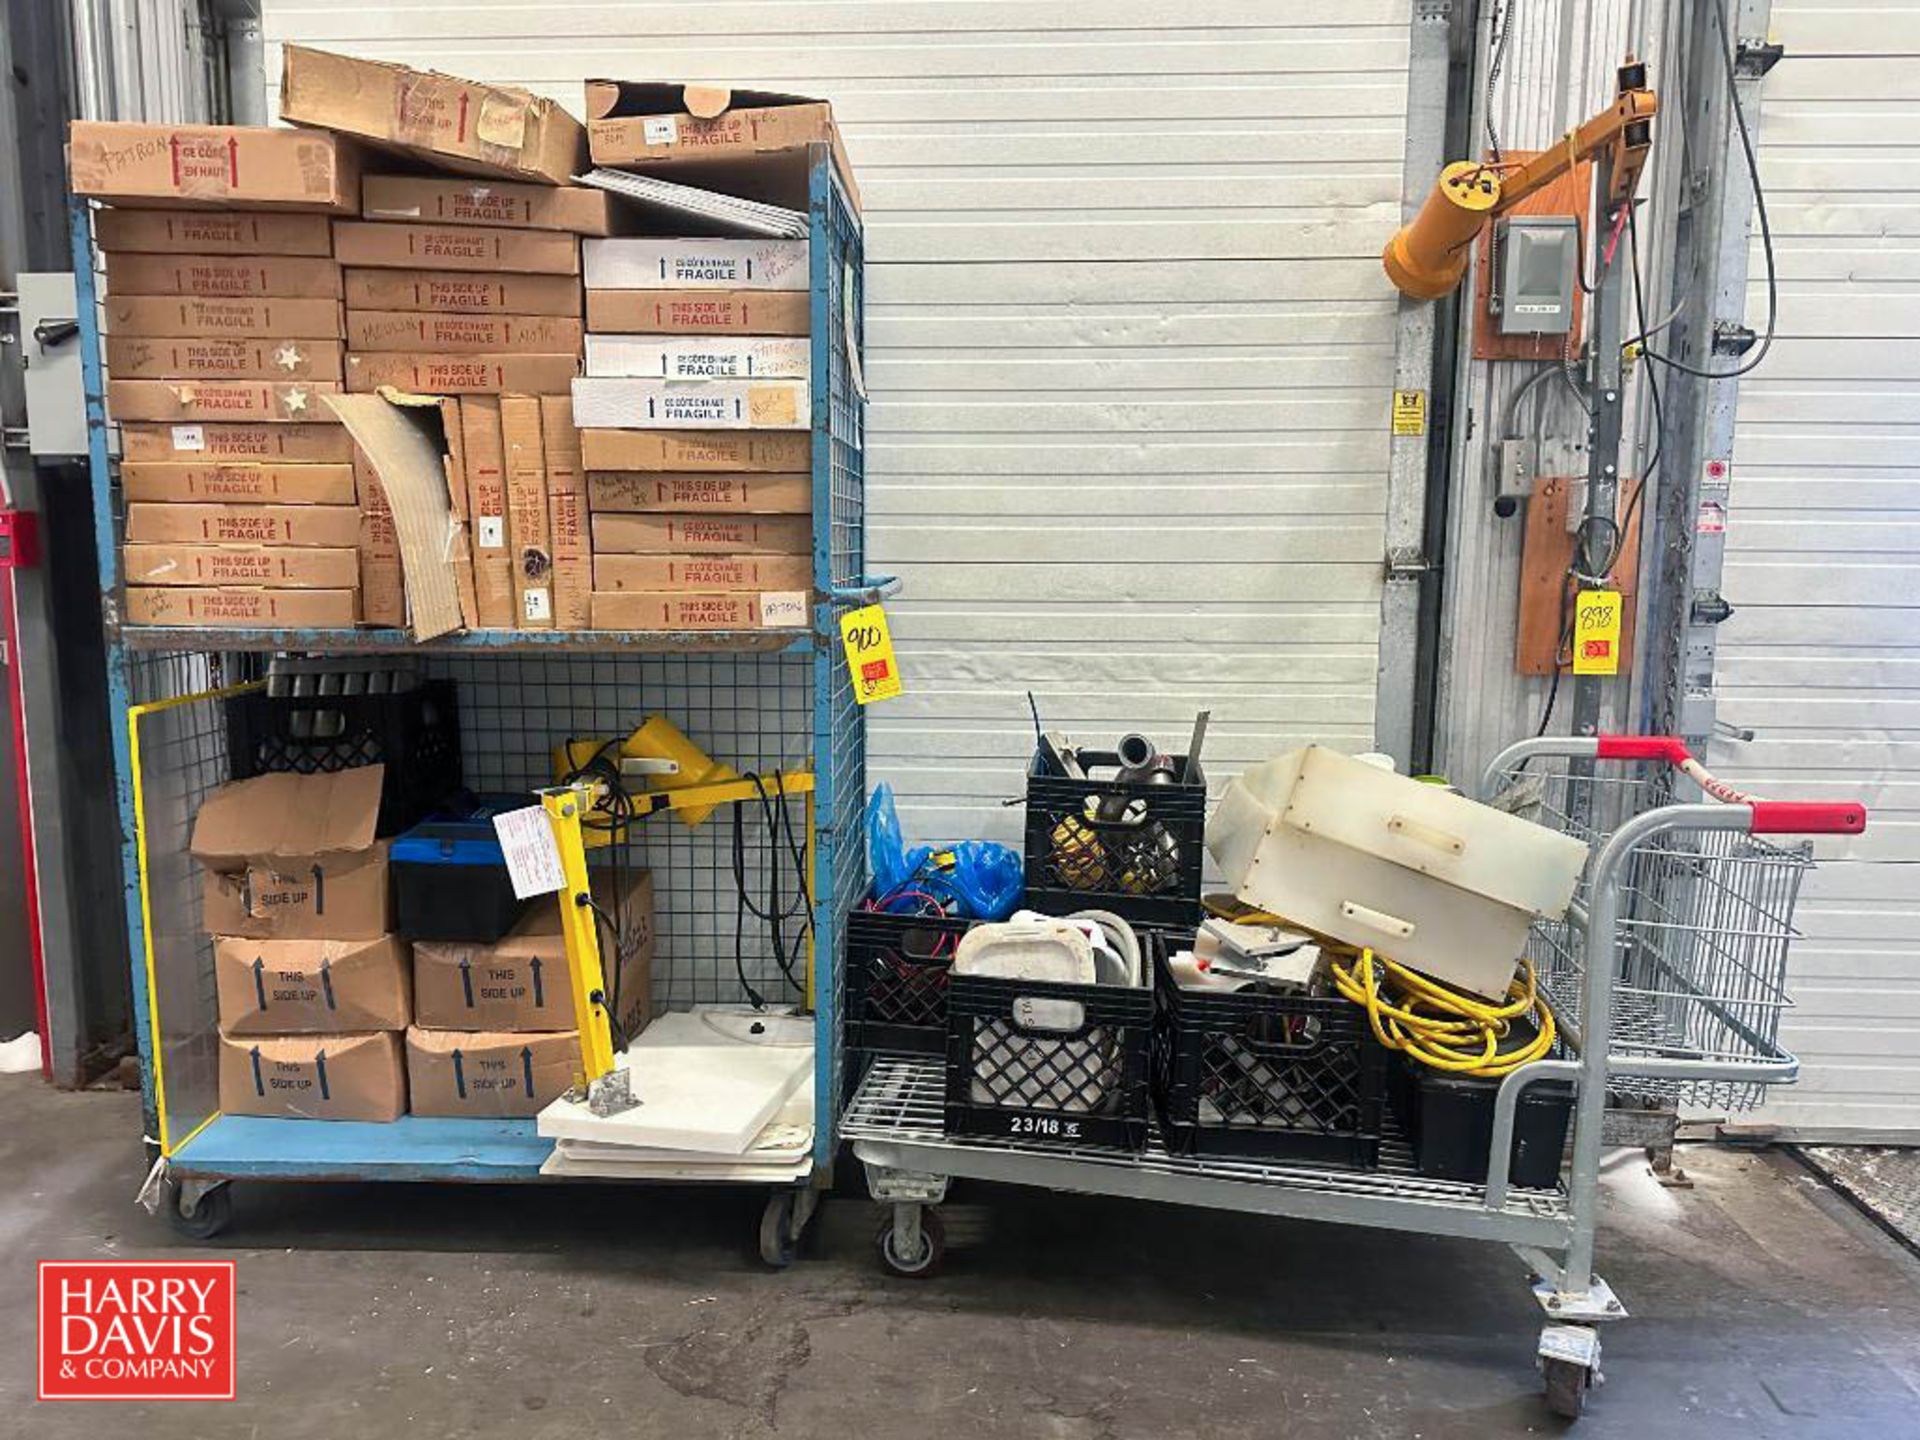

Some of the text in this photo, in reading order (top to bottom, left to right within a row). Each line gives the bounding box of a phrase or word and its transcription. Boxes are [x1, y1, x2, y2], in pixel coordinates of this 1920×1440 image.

[681, 132, 742, 147] FRAGILE
[454, 207, 515, 220] FRAGILE
[425, 245, 485, 257] FRAGILE
[677, 269, 736, 280] FRAGILE
[431, 295, 488, 306] FRAGILE
[672, 314, 732, 325] FRAGILE
[436, 331, 494, 343] FRAGILE
[188, 359, 247, 370] FRAGILE
[678, 364, 737, 375] FRAGILE
[430, 375, 487, 387] FRAGILE
[195, 399, 254, 409] FRAGILE
[666, 409, 725, 419] FRAGILE
[210, 444, 269, 454] FRAGILE
[205, 484, 262, 495] FRAGILE
[673, 492, 733, 503] FRAGILE
[527, 488, 540, 545] FRAGILE
[564, 486, 578, 546] FRAGILE
[218, 529, 277, 540] FRAGILE
[685, 531, 743, 542] FRAGILE
[212, 567, 271, 578] FRAGILE
[684, 572, 743, 583] FRAGILE
[203, 606, 261, 617] FRAGILE
[681, 612, 737, 622] FRAGILE
[847, 626, 881, 653] 900
[262, 892, 309, 906] SIDE UP
[273, 989, 317, 1001] SIDE UP
[480, 987, 526, 999] SIDE UP
[269, 1078, 312, 1090] SIDE UP
[1010, 1117, 1060, 1134] 23/18
